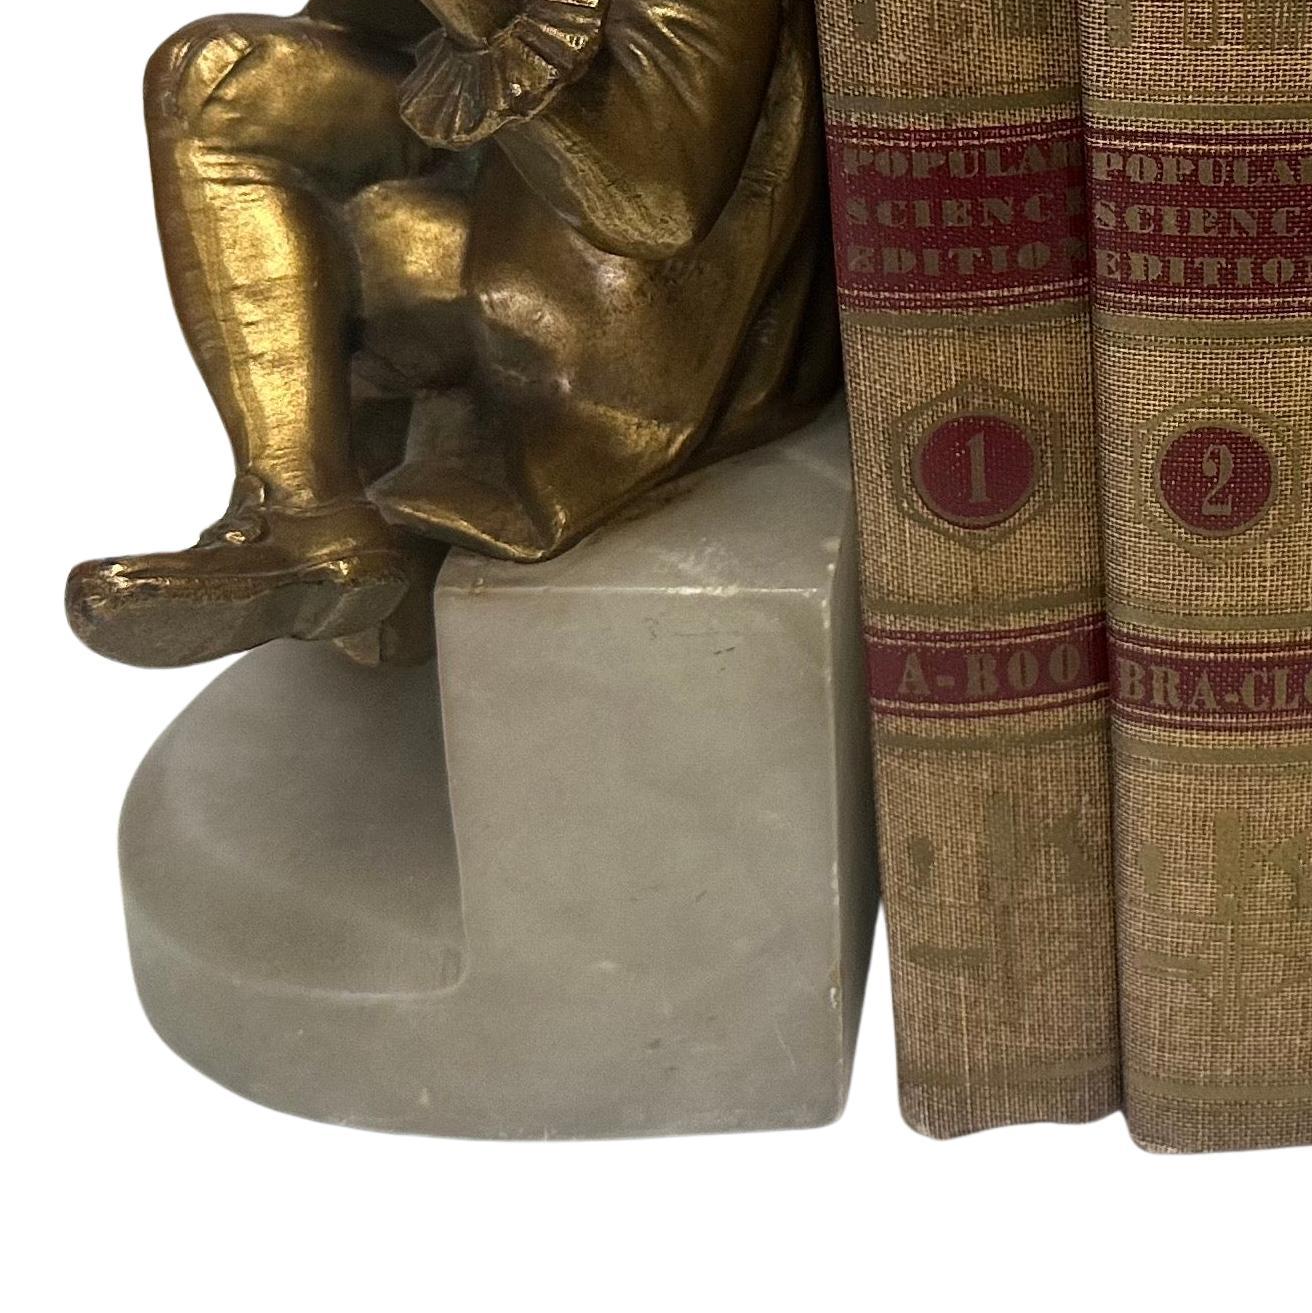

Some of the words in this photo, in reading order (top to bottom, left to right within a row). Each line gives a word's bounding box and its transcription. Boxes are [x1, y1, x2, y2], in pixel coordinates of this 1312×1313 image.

[843, 140, 1083, 179] POPULAR
[966, 430, 993, 504] 1
[1202, 444, 1234, 516] 2
[898, 644, 1082, 696] A-BOO
